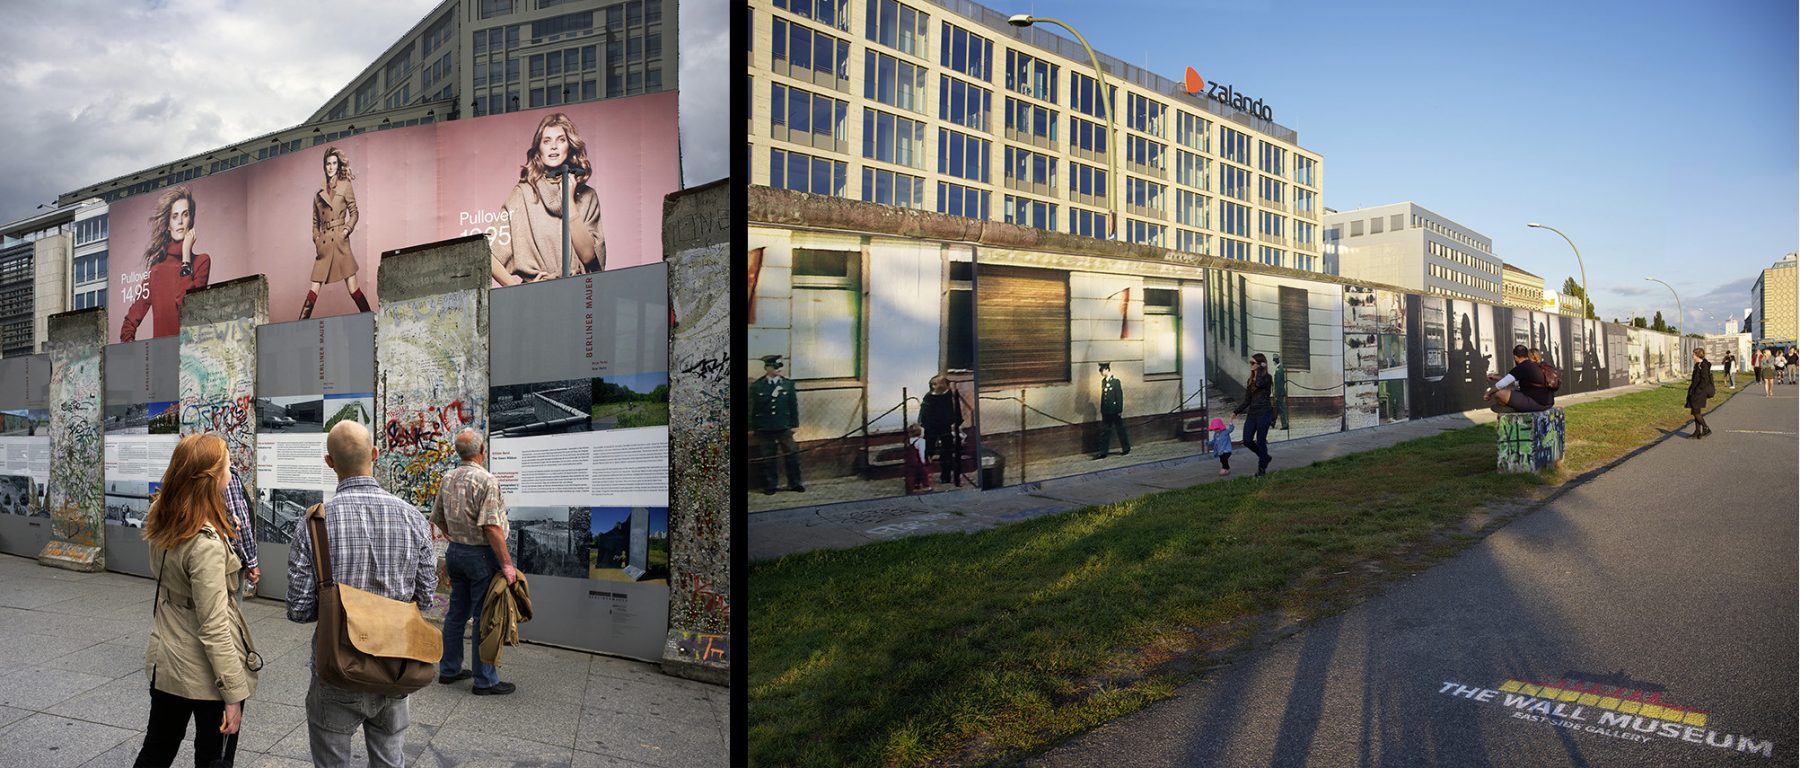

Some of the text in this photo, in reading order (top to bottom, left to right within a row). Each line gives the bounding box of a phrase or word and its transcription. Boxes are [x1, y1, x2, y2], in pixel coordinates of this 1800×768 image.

[1207, 80, 1273, 122] zalando
[460, 209, 514, 226] Pullover
[121, 270, 152, 285] Pullover
[585, 277, 593, 358] BERLINER MAUER
[1439, 681, 1774, 758] THE WALL MUSEUM
[1512, 711, 1651, 743] EAST SIDE GALLERY
